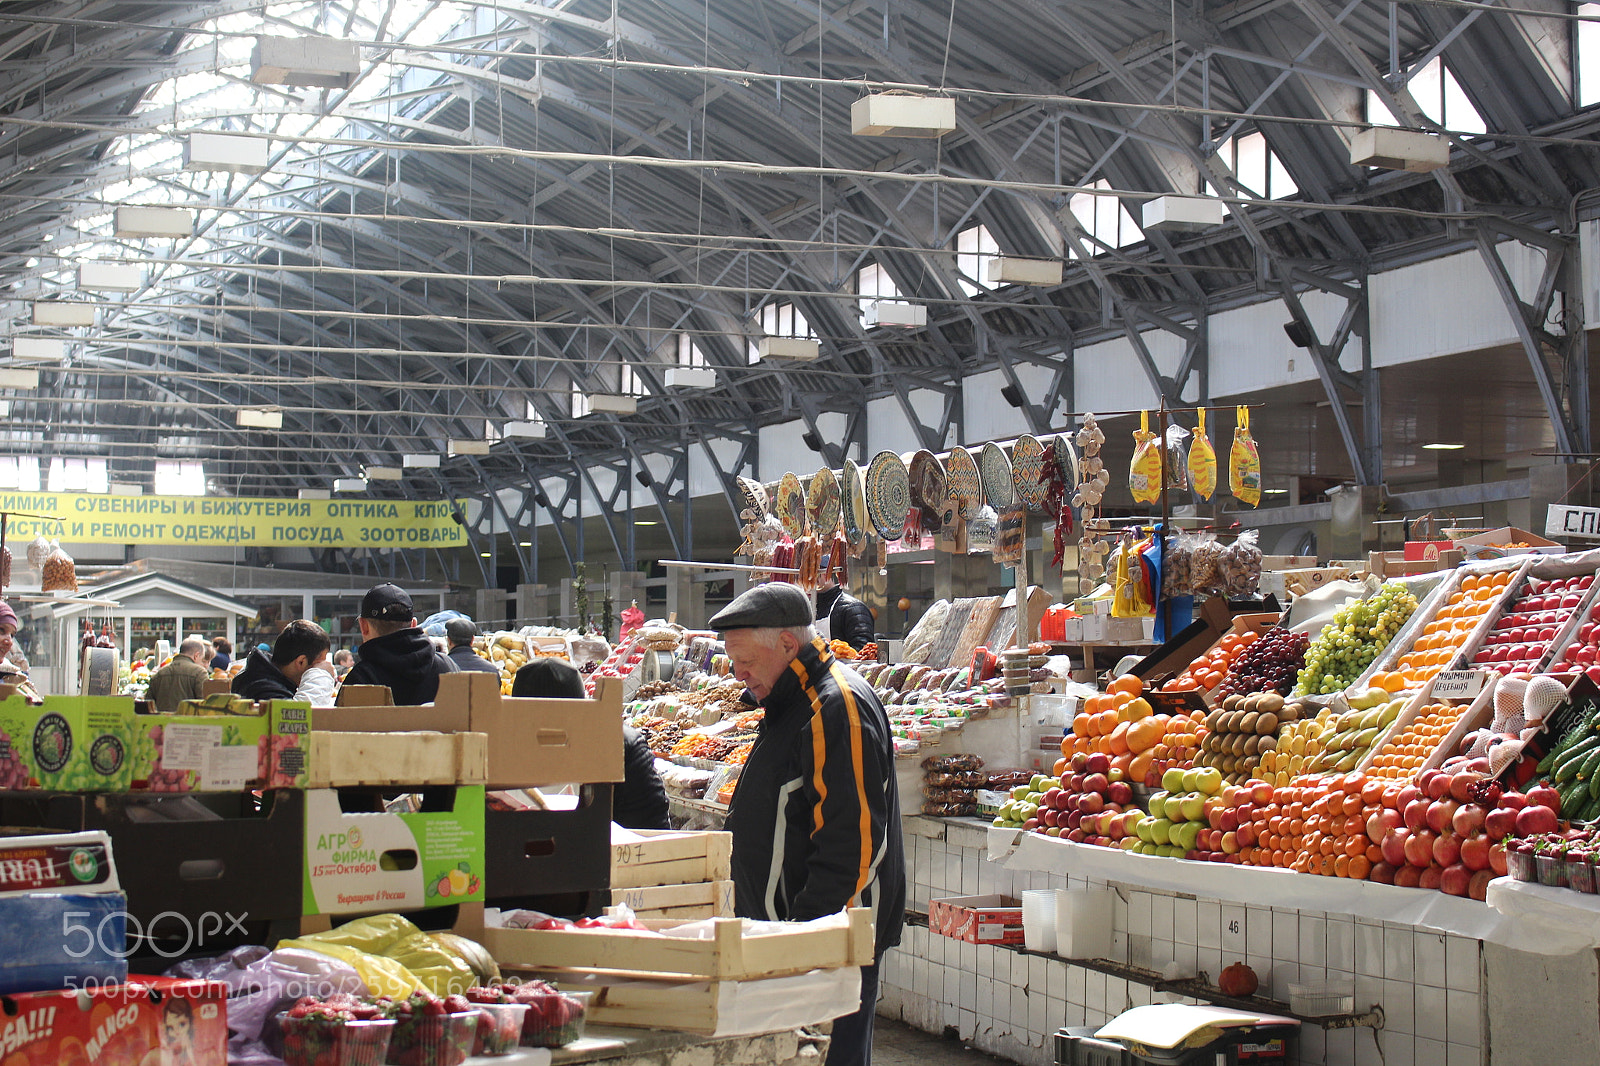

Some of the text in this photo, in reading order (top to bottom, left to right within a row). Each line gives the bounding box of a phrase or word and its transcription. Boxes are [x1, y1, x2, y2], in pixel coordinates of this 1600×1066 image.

[74, 497, 177, 515] СУВЕНИРЫ
[183, 500, 195, 515] И
[201, 500, 311, 518] БИЖУТЕРИЯ
[327, 502, 399, 519] ОПТИКА
[4, 520, 461, 544] ИСТКА И РЕМОНТ ОДЕЖДЫ ПОСУДА ЗООТОВАРЫ
[281, 708, 307, 720] TABLE
[278, 722, 309, 735] GRAPES
[331, 848, 377, 864] ФИРМА
[312, 865, 324, 877] 15
[336, 862, 377, 876] Октября
[1229, 920, 1239, 934] 46
[85, 1003, 139, 1063] MANGO
